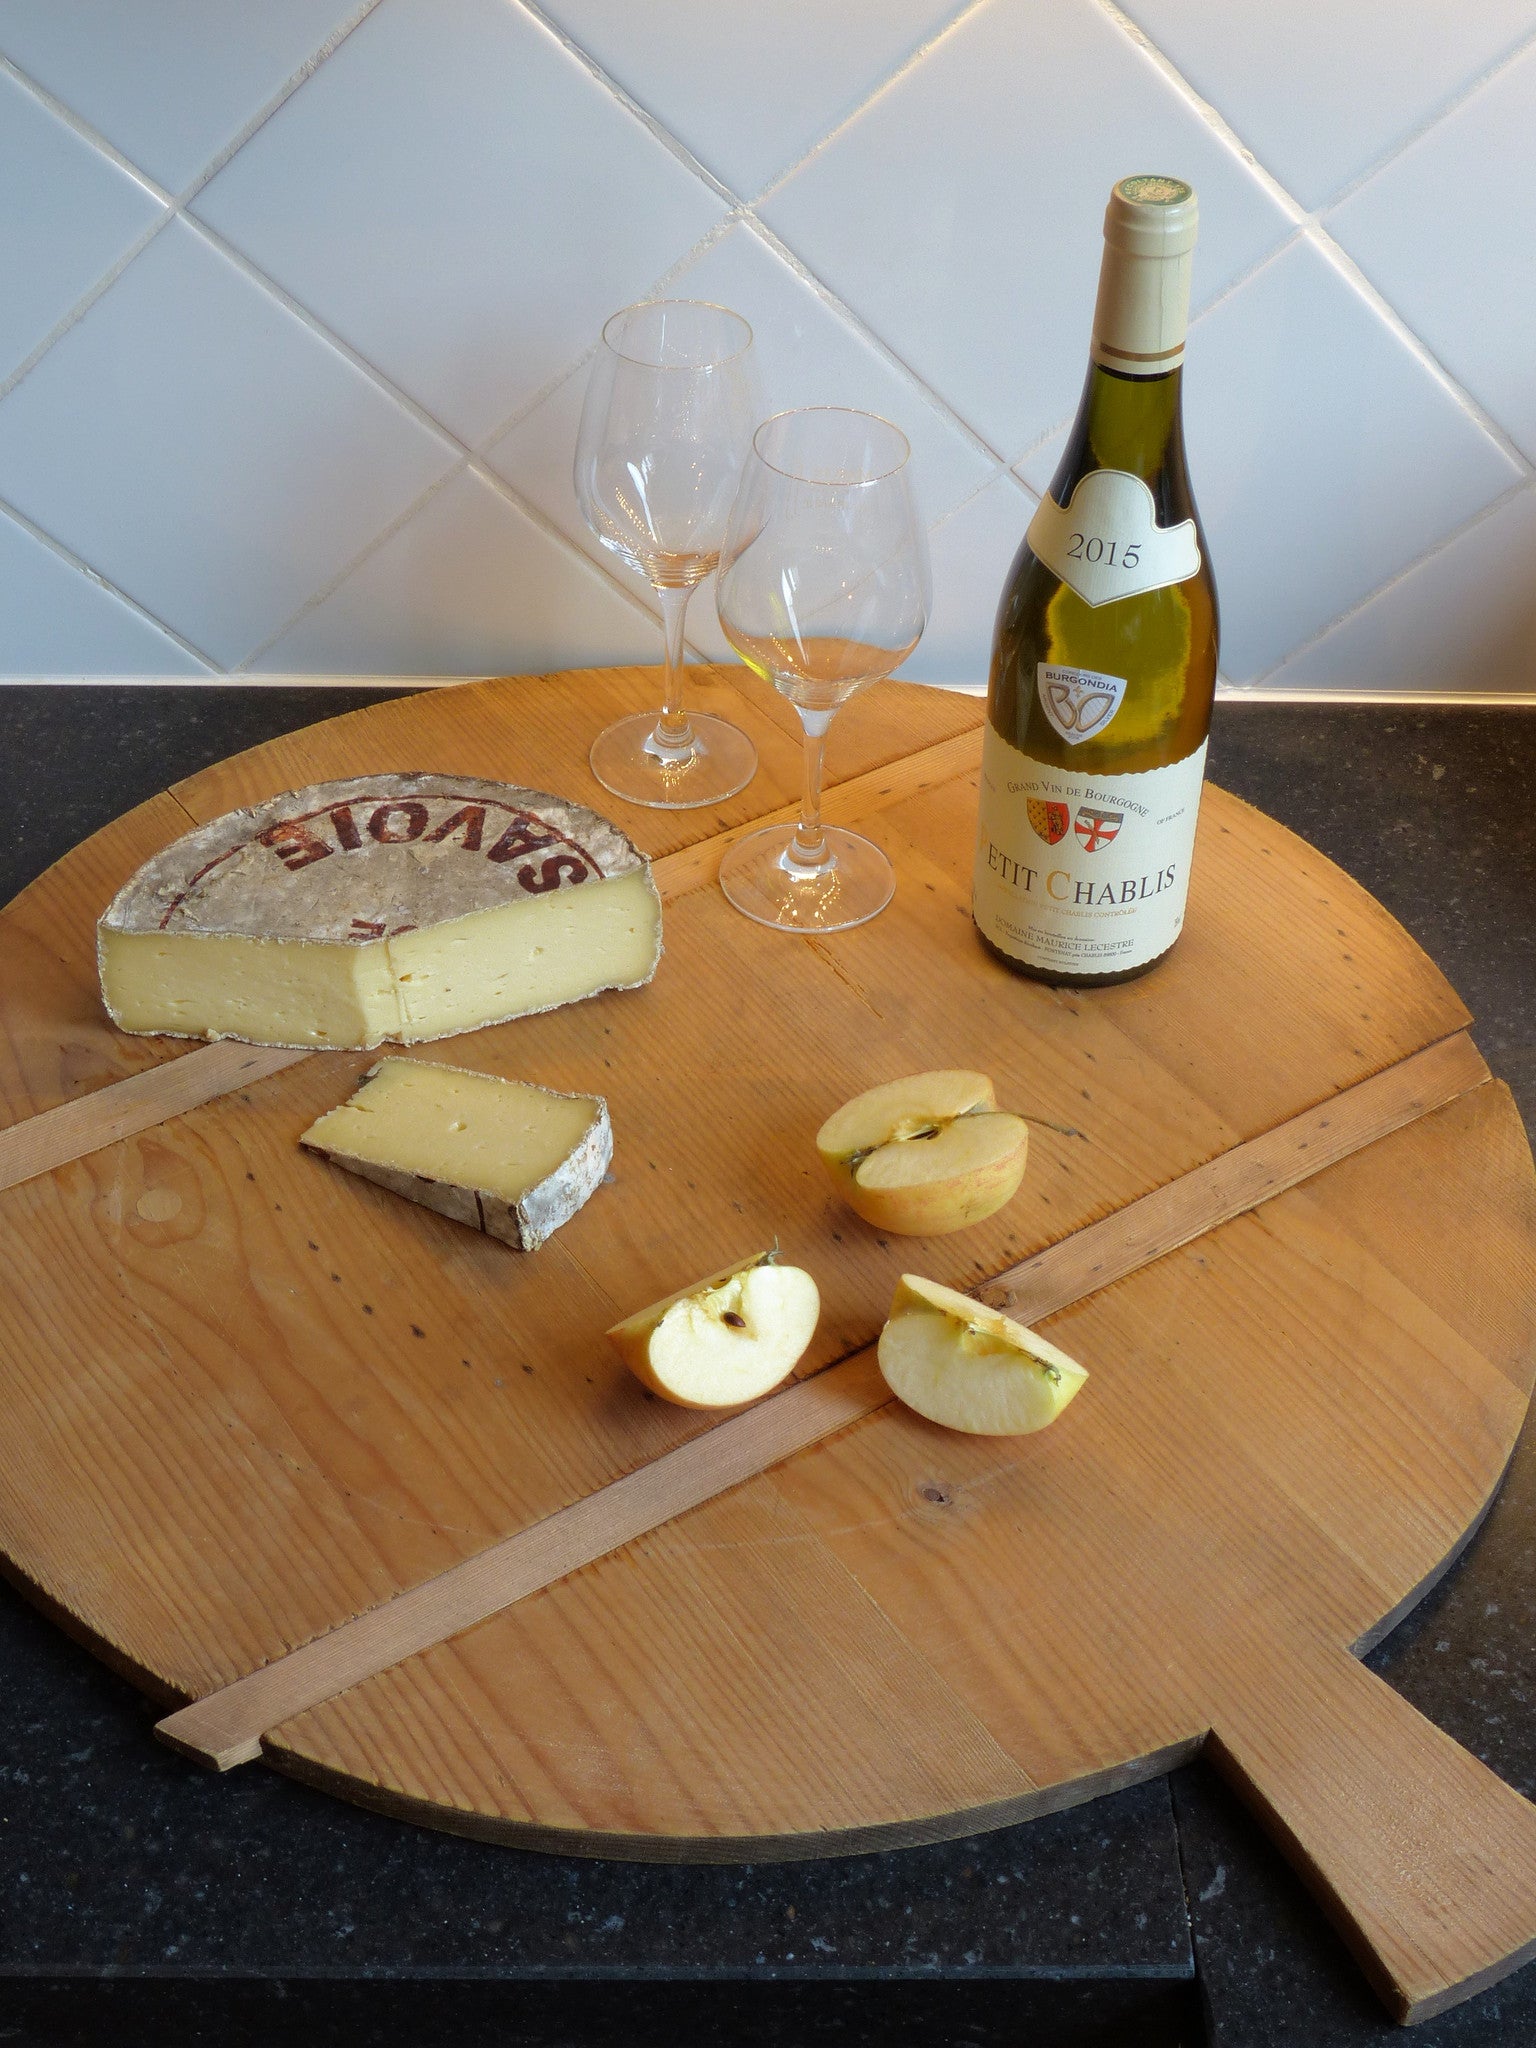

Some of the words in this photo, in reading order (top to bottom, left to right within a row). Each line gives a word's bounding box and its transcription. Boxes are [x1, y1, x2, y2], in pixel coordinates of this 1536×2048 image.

[1067, 533, 1142, 569] 2015
[1045, 671, 1118, 693] BURGONDIA
[1007, 781, 1040, 793] GRAND
[1040, 781, 1062, 793] VIN
[1084, 788, 1150, 818] BOURGOGNE
[256, 800, 590, 895] SAVOIE
[1046, 863, 1176, 906] CHABLIS
[995, 914, 1034, 941] DOMAINE
[1036, 935, 1082, 951] MAURICE
[1084, 938, 1134, 952] LECESTRE
